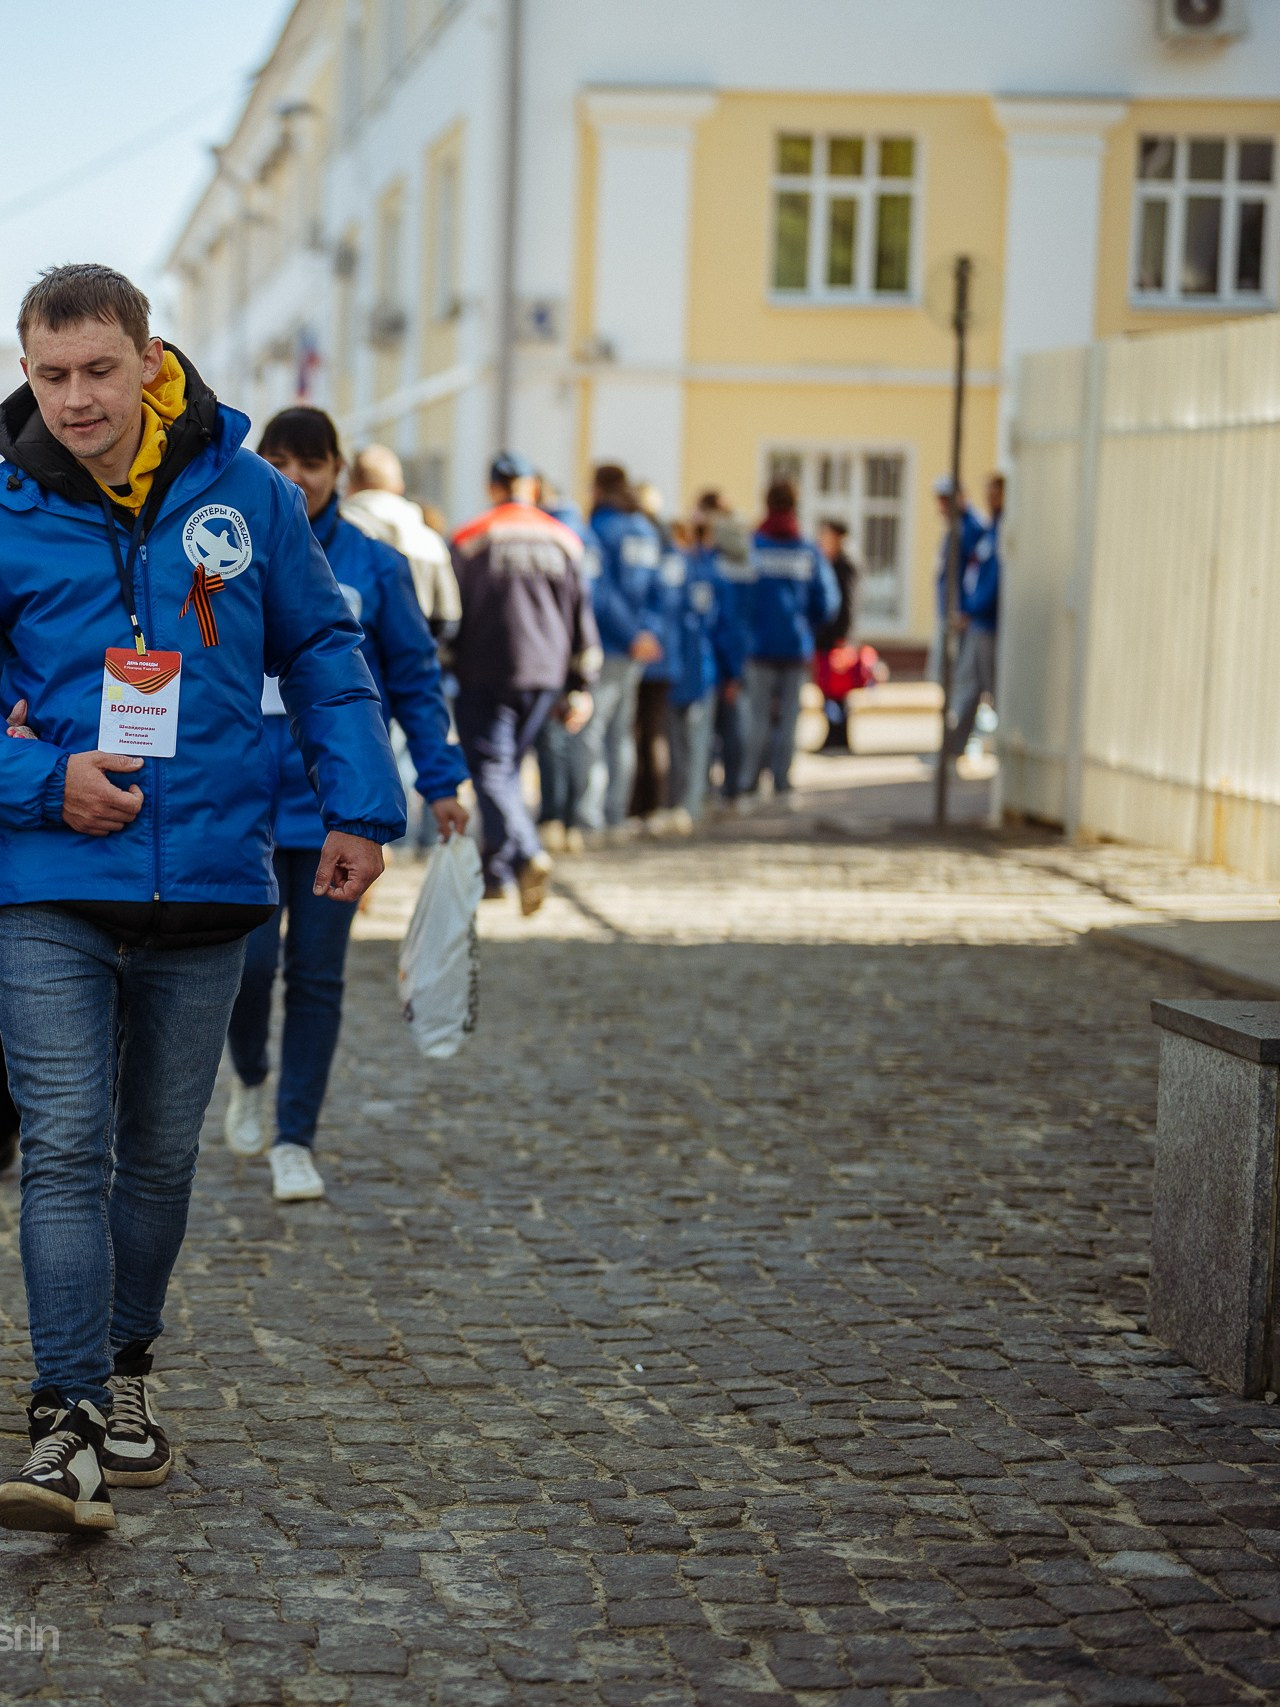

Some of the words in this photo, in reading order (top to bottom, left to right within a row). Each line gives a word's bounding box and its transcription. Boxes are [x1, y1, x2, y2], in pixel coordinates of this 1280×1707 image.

[186, 506, 227, 541] ВОЛОНТЁРЫ
[229, 510, 250, 547] ПОБЕДЫ
[110, 704, 167, 716] ВОЛОНТЕР
